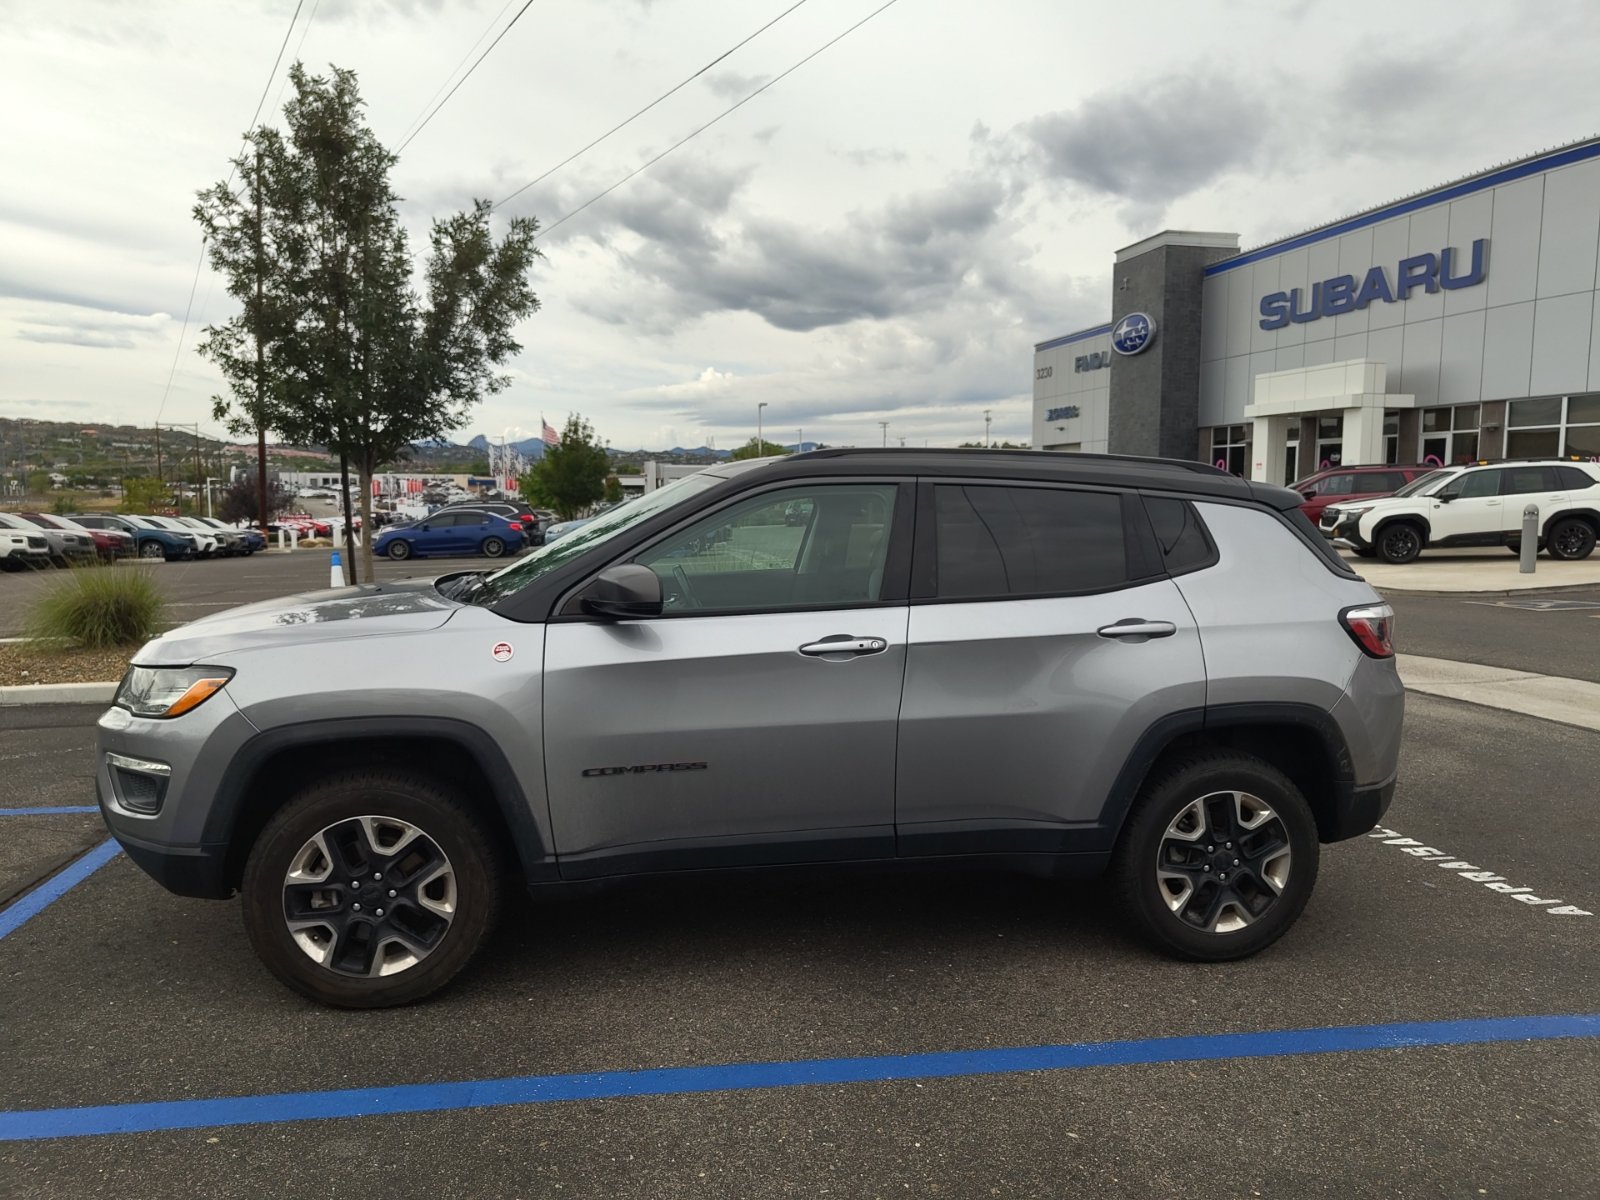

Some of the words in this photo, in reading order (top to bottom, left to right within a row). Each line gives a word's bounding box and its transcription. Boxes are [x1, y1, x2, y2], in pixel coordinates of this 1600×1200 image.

[1259, 238, 1488, 331] SUBARU
[1036, 366, 1053, 380] 3230
[581, 761, 708, 778] COMPASS
[1368, 824, 1595, 916] APPRAISAL
